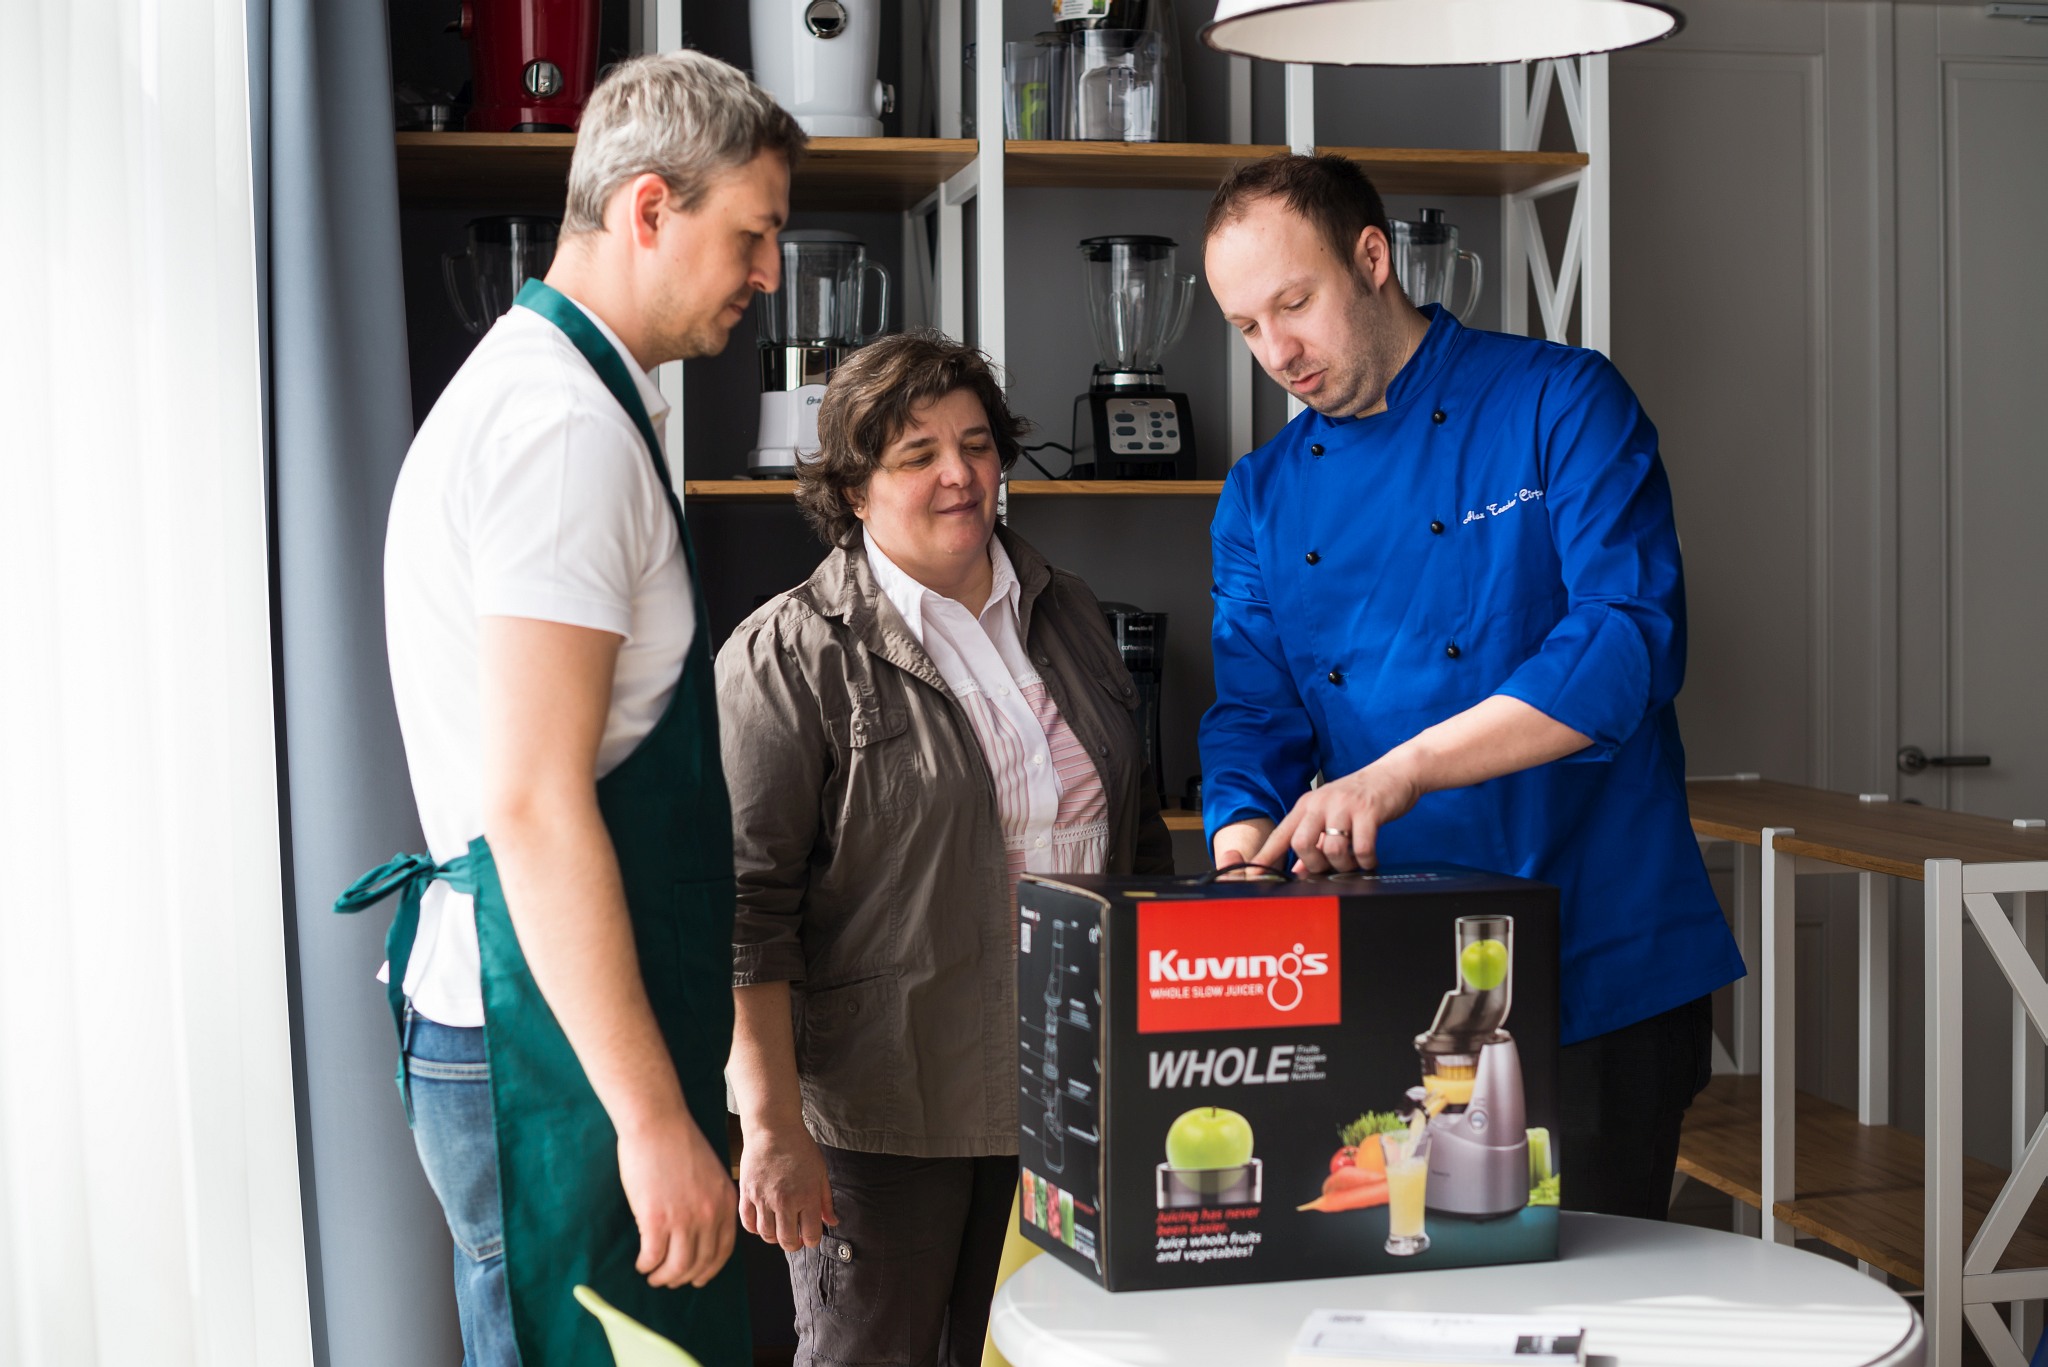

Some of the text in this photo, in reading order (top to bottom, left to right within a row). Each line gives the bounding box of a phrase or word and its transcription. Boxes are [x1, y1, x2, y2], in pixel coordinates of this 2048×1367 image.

[1149, 983, 1264, 999] WHOLE SLOW JUICER
[1149, 1045, 1295, 1089] WHOLE
[1225, 1207, 1260, 1219] never
[1156, 1223, 1188, 1237] been
[1155, 1231, 1262, 1250] Juice whole fruits
[1156, 1244, 1254, 1263] and vegetables!
